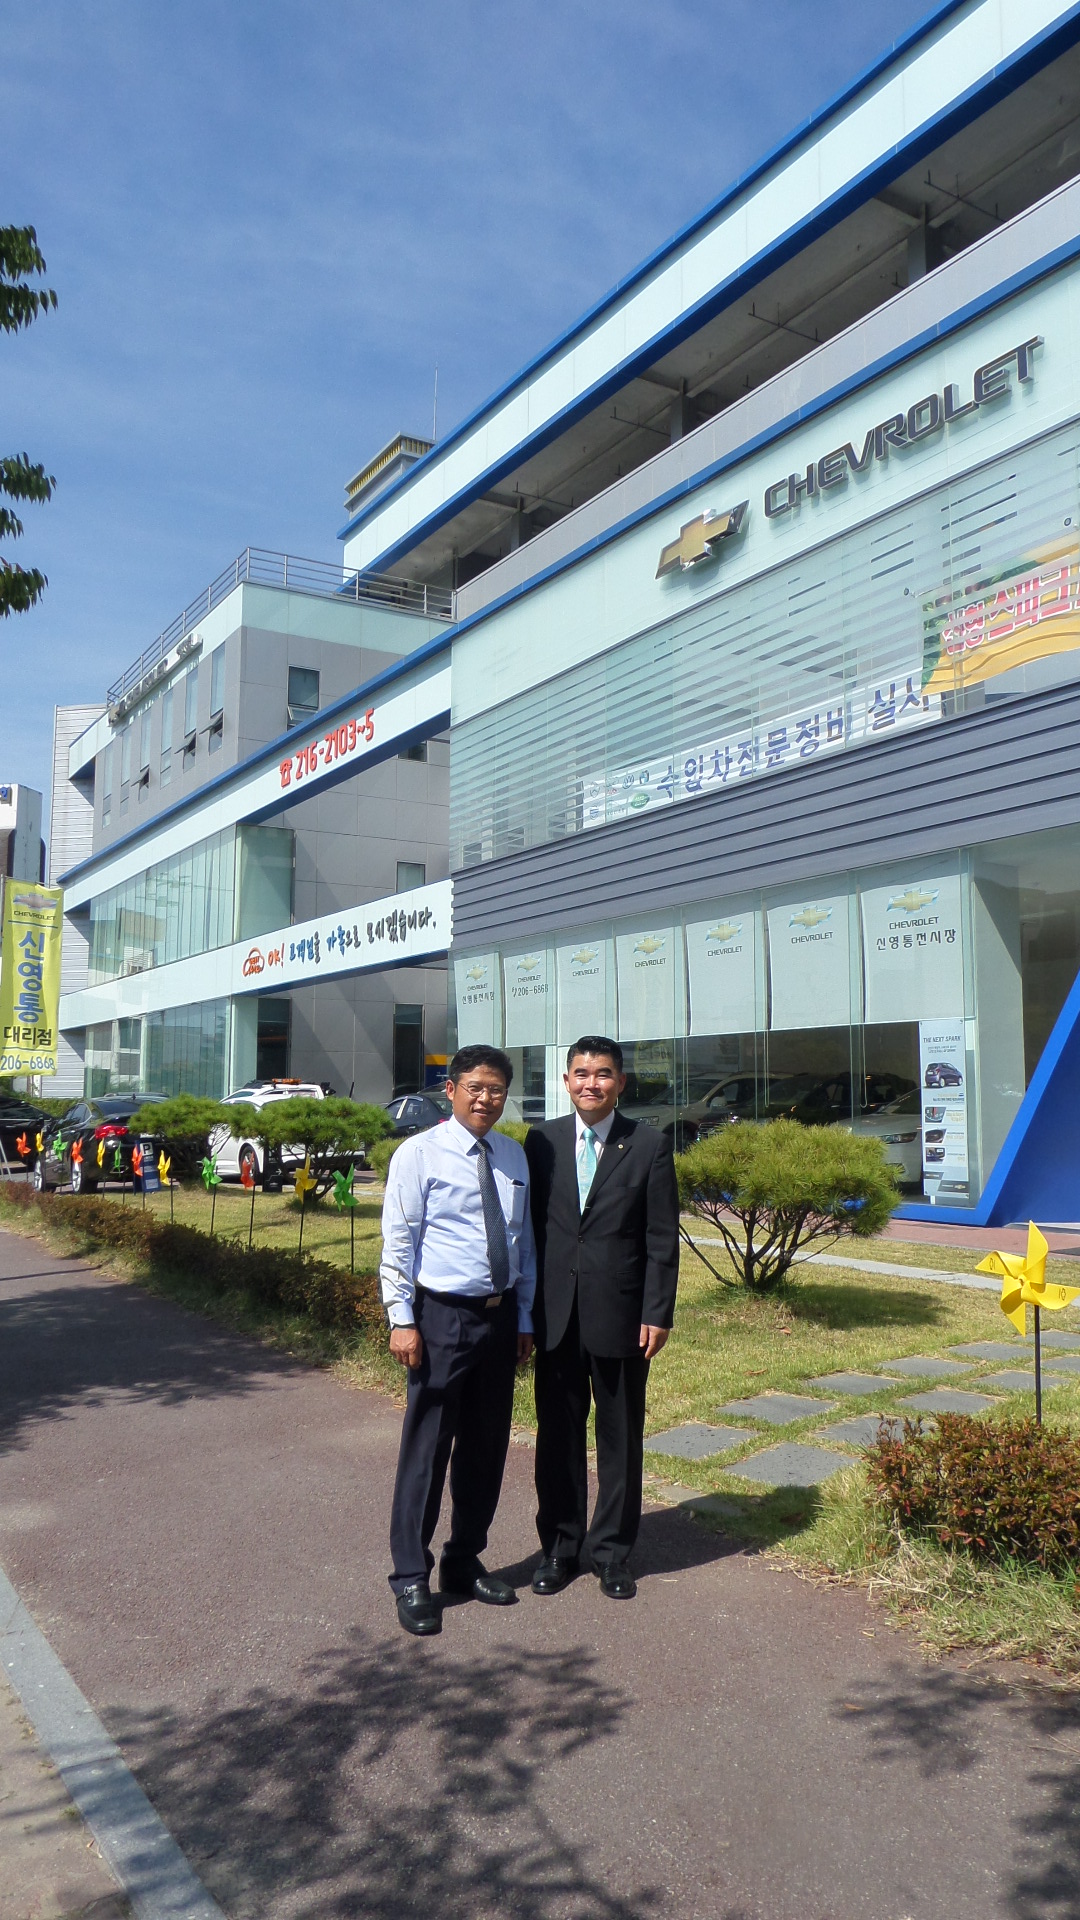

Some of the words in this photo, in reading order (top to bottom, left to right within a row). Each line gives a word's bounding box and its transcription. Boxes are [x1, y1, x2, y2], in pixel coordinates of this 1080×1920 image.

[765, 335, 1045, 519] CHEVROLET
[296, 708, 375, 780] 216-2103~5
[656, 701, 854, 799] 수입차전문정비
[867, 676, 930, 732] 실시
[13, 910, 57, 921] CHEVROLET
[889, 916, 940, 930] CHEVROLET
[791, 931, 834, 944] CHEVROLET
[876, 929, 957, 951] 신영통전시장
[267, 943, 285, 968] OK!
[707, 946, 743, 957] CHEVROLET
[634, 957, 666, 968] CHEVROLET
[13, 930, 46, 1024] 신영통
[517, 974, 542, 983] CHEVROLET
[572, 967, 600, 977] CHEVROLET
[3, 1025, 53, 1047] 대리점
[0, 1054, 56, 1072] 206-6868
[143, 1144, 151, 1155] P
